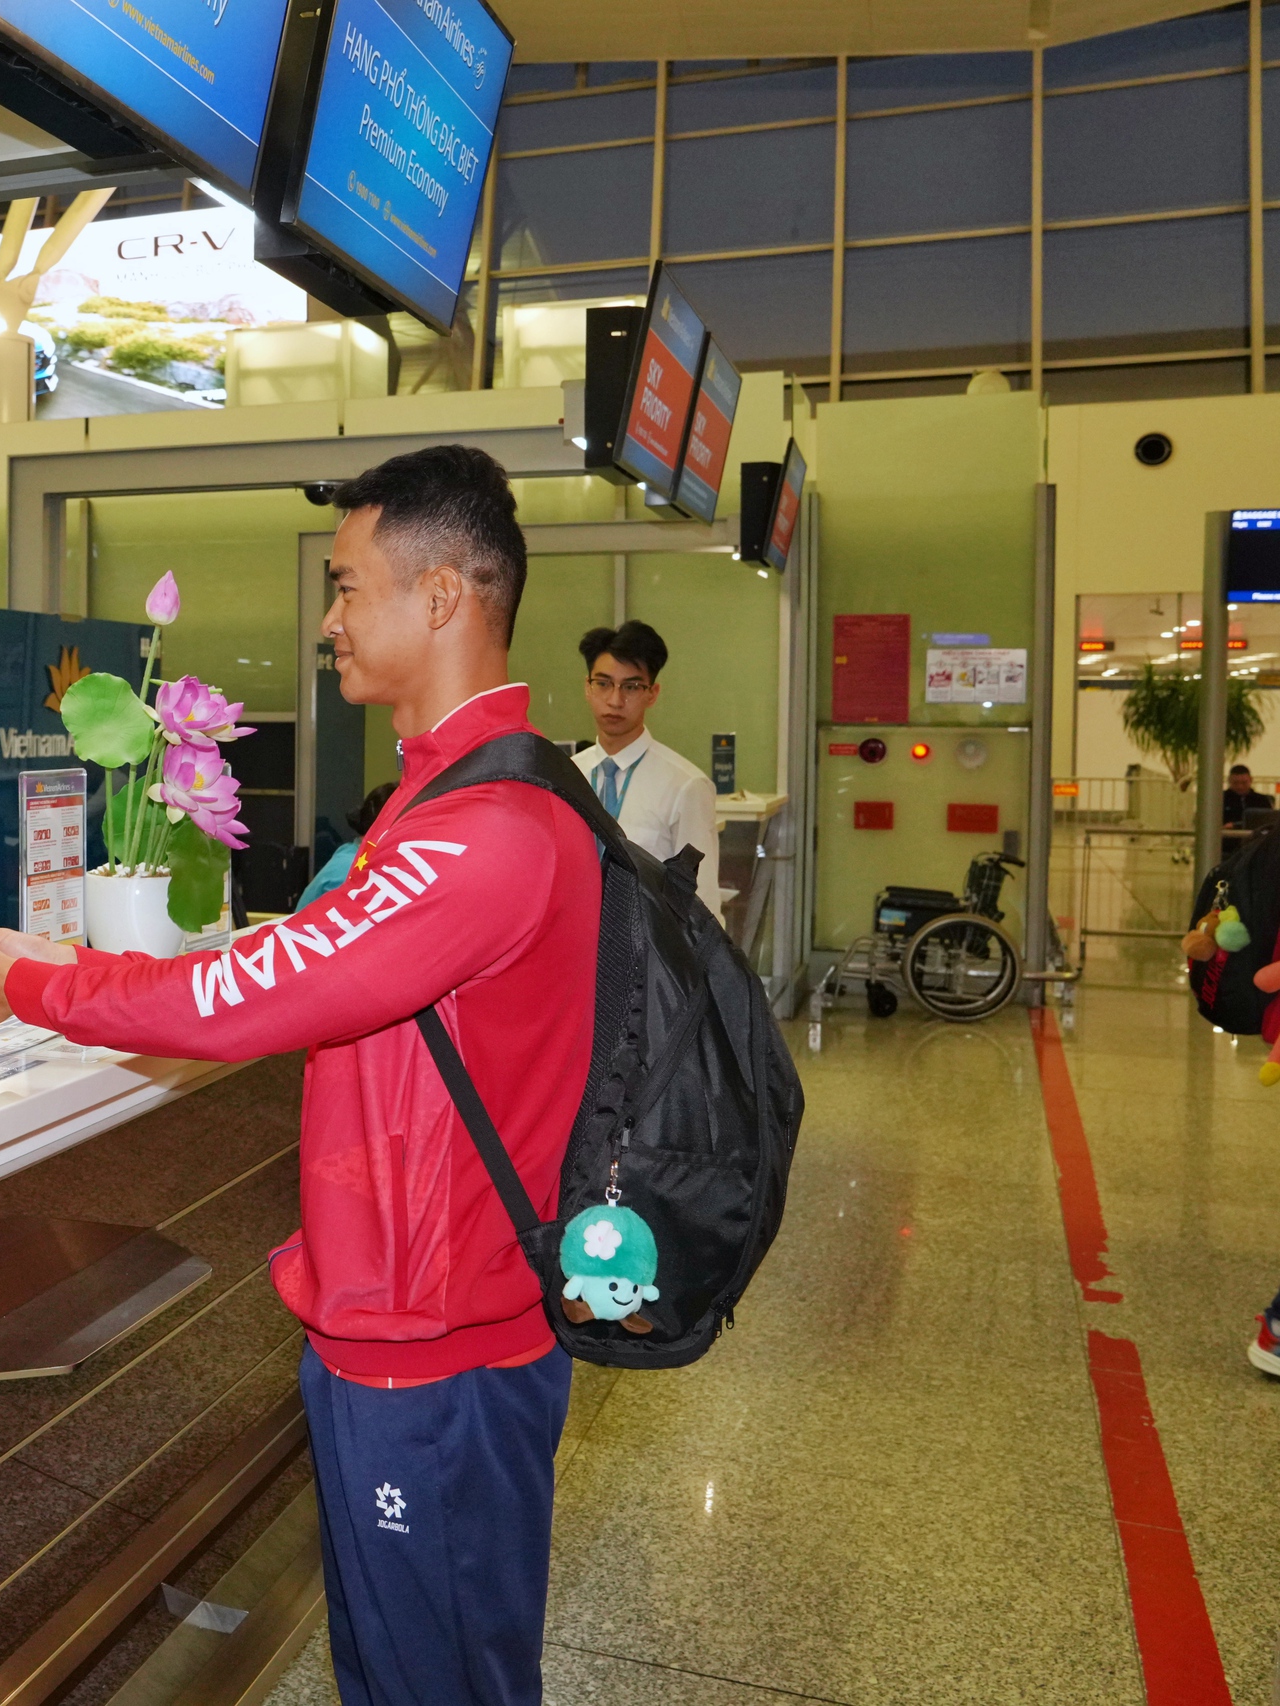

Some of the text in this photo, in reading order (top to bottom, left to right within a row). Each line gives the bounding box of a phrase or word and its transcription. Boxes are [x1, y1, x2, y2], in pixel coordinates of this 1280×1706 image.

[342, 21, 480, 187] HẠNG PHỔ THÔNG ĐẶC BIỆT
[358, 103, 449, 218] Premium Economy
[117, 227, 236, 261] CR-V
[646, 358, 664, 391] SKY
[640, 386, 672, 432] PRIORITY
[192, 840, 467, 1018] VIETNAM
[377, 1519, 410, 1534] JOCARBOLA
